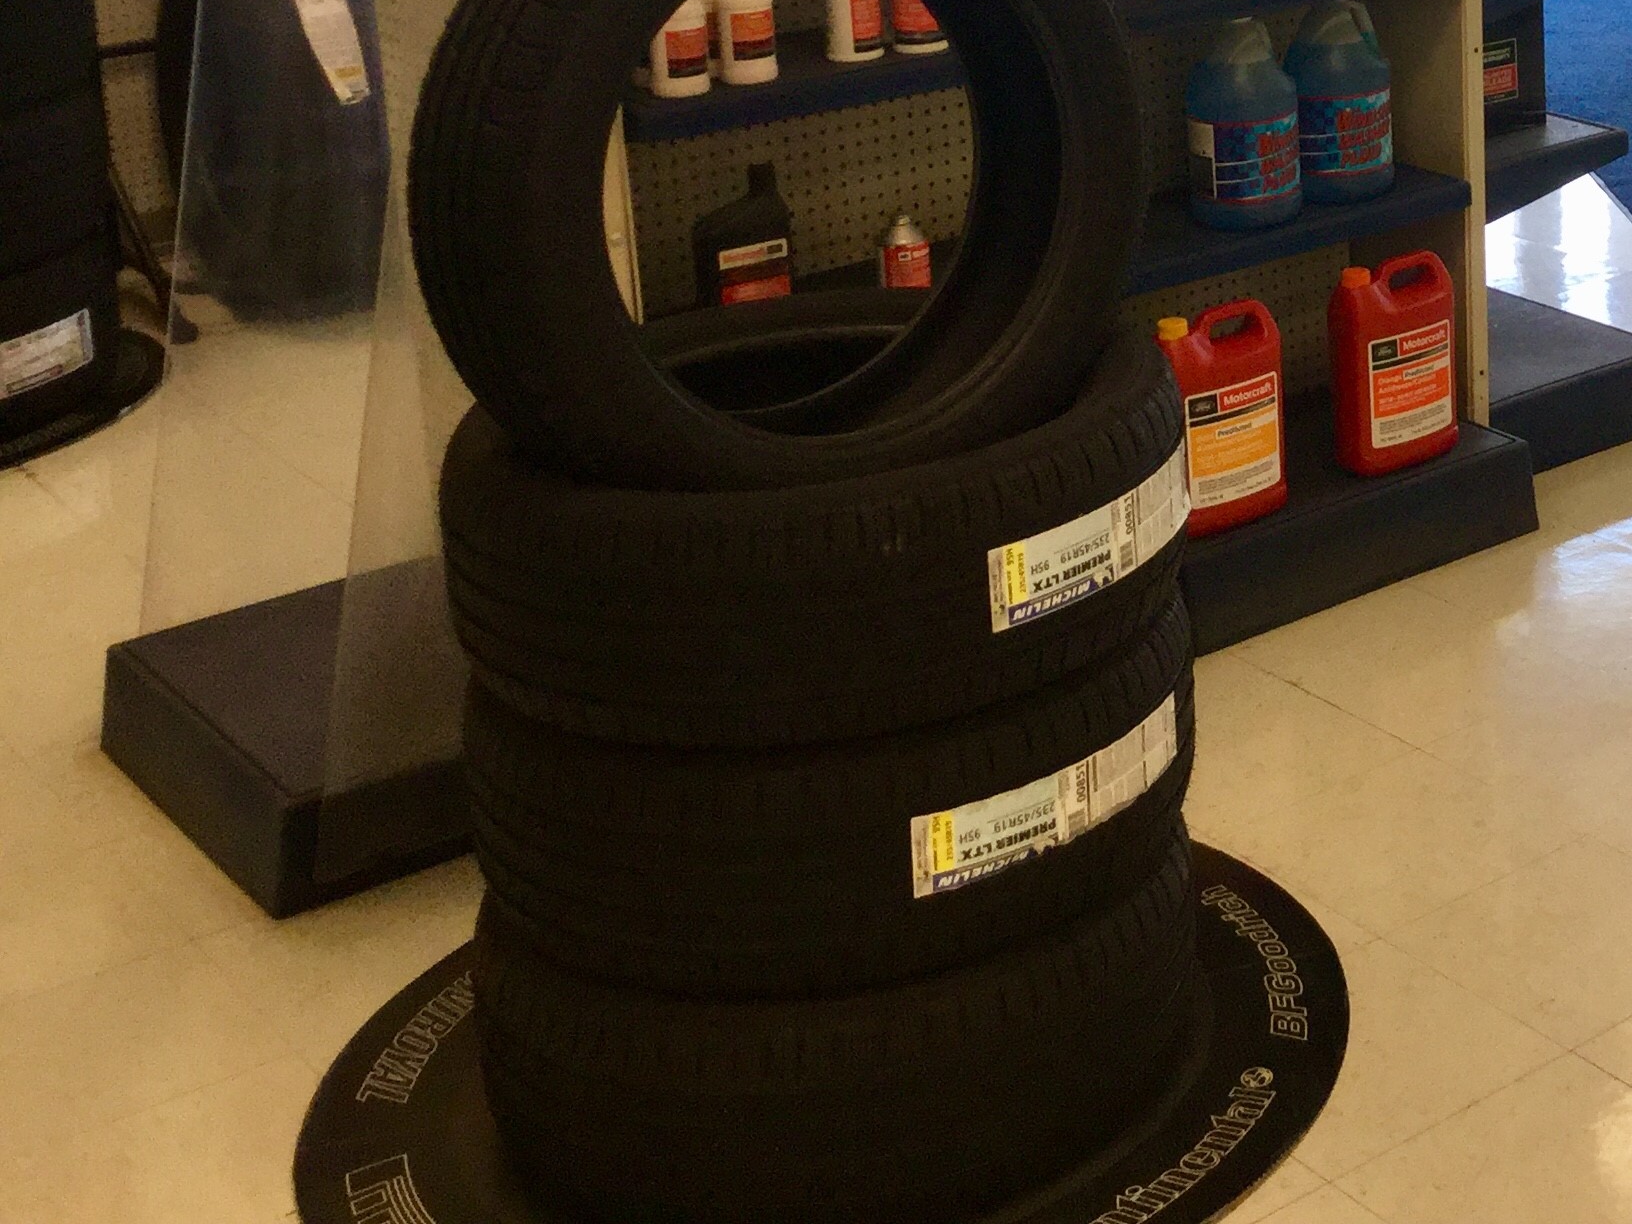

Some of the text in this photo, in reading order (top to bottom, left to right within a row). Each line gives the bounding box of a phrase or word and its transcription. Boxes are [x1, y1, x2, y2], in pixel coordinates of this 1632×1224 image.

[1402, 329, 1447, 351] Motorcraft
[1223, 381, 1272, 407] Motorcraft
[1124, 495, 1134, 534] 00851
[1030, 532, 1110, 575] 235/45R19 95H
[1062, 550, 1112, 580] PREMIER
[1012, 580, 1091, 621] MICHELIN
[1032, 573, 1059, 594] LTX
[1076, 762, 1086, 803] 00851
[958, 802, 1056, 843] 235/45R19 95H
[959, 817, 1057, 861] PREMIER LTX
[1201, 884, 1308, 1041] BFGoodrich
[355, 970, 475, 1104] NIROYAL
[1088, 1079, 1277, 1224] ntinental
